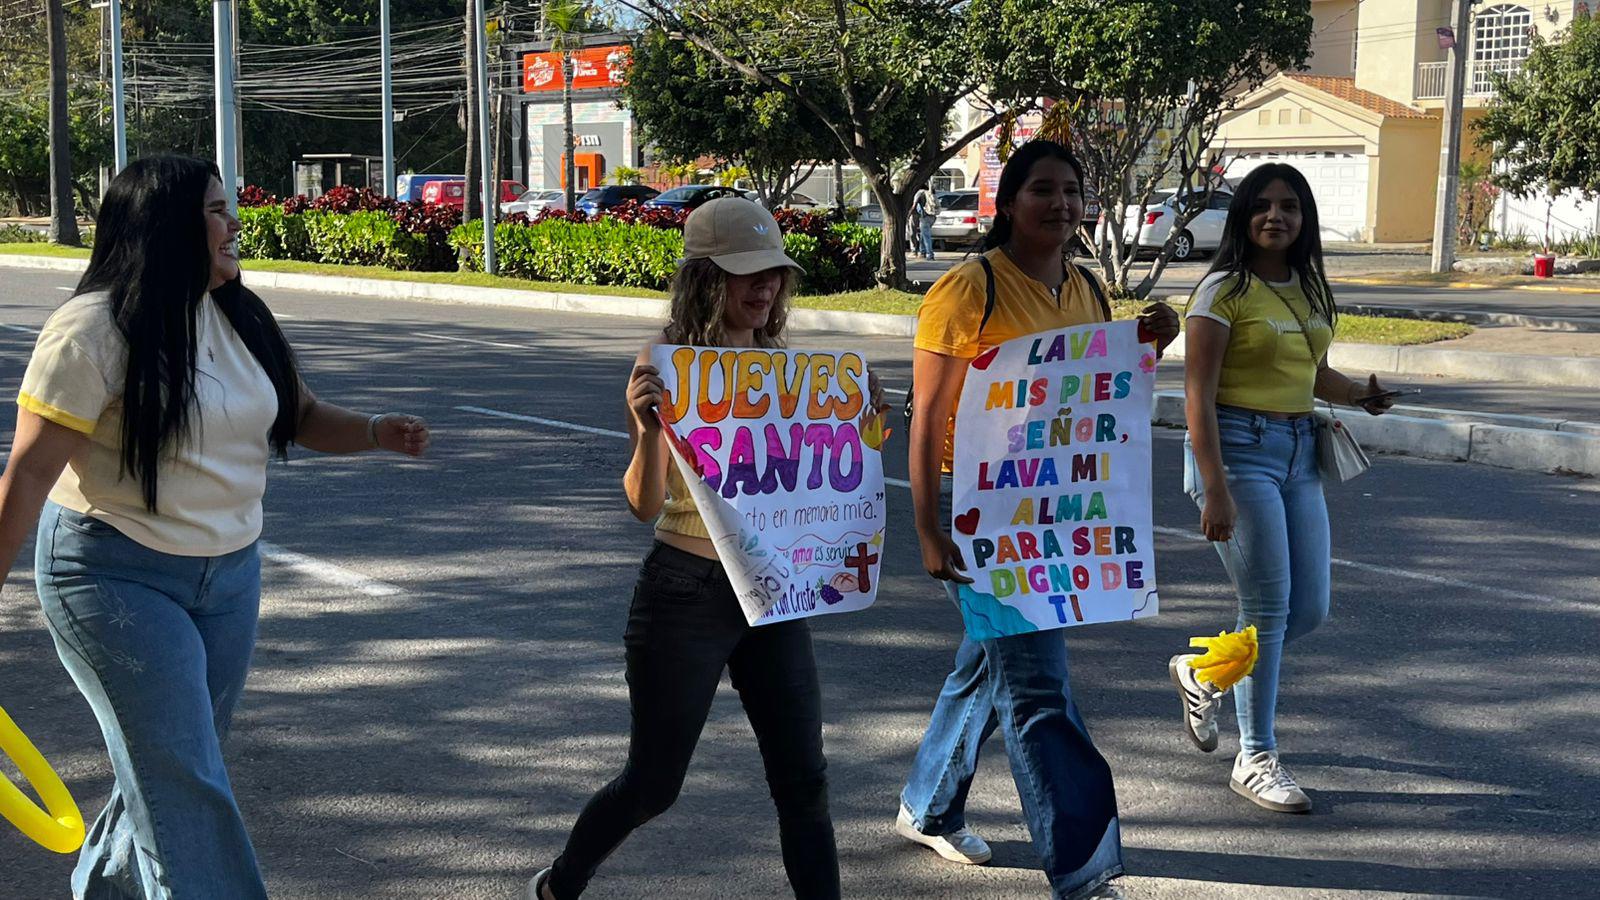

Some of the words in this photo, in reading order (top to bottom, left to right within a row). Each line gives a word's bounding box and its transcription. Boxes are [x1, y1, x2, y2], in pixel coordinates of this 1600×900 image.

[1027, 329, 1108, 365] LAVA
[658, 347, 864, 424] JUEVES
[985, 377, 1048, 411] MIS
[1059, 371, 1133, 404] PIES
[1007, 407, 1129, 453] SEÑOR,
[687, 422, 864, 498] SANTO
[977, 457, 1059, 490] LAVA
[1071, 452, 1110, 483] MI
[773, 508, 788, 528] en
[794, 500, 839, 526] memoria
[1010, 491, 1108, 525] ALMA
[815, 545, 824, 561] es
[972, 529, 1064, 569] PARA
[1071, 526, 1137, 556] SER
[790, 580, 816, 613] Cristo
[989, 563, 1090, 598] DIGNO
[1100, 560, 1144, 591] DE
[1048, 594, 1084, 624] TI
